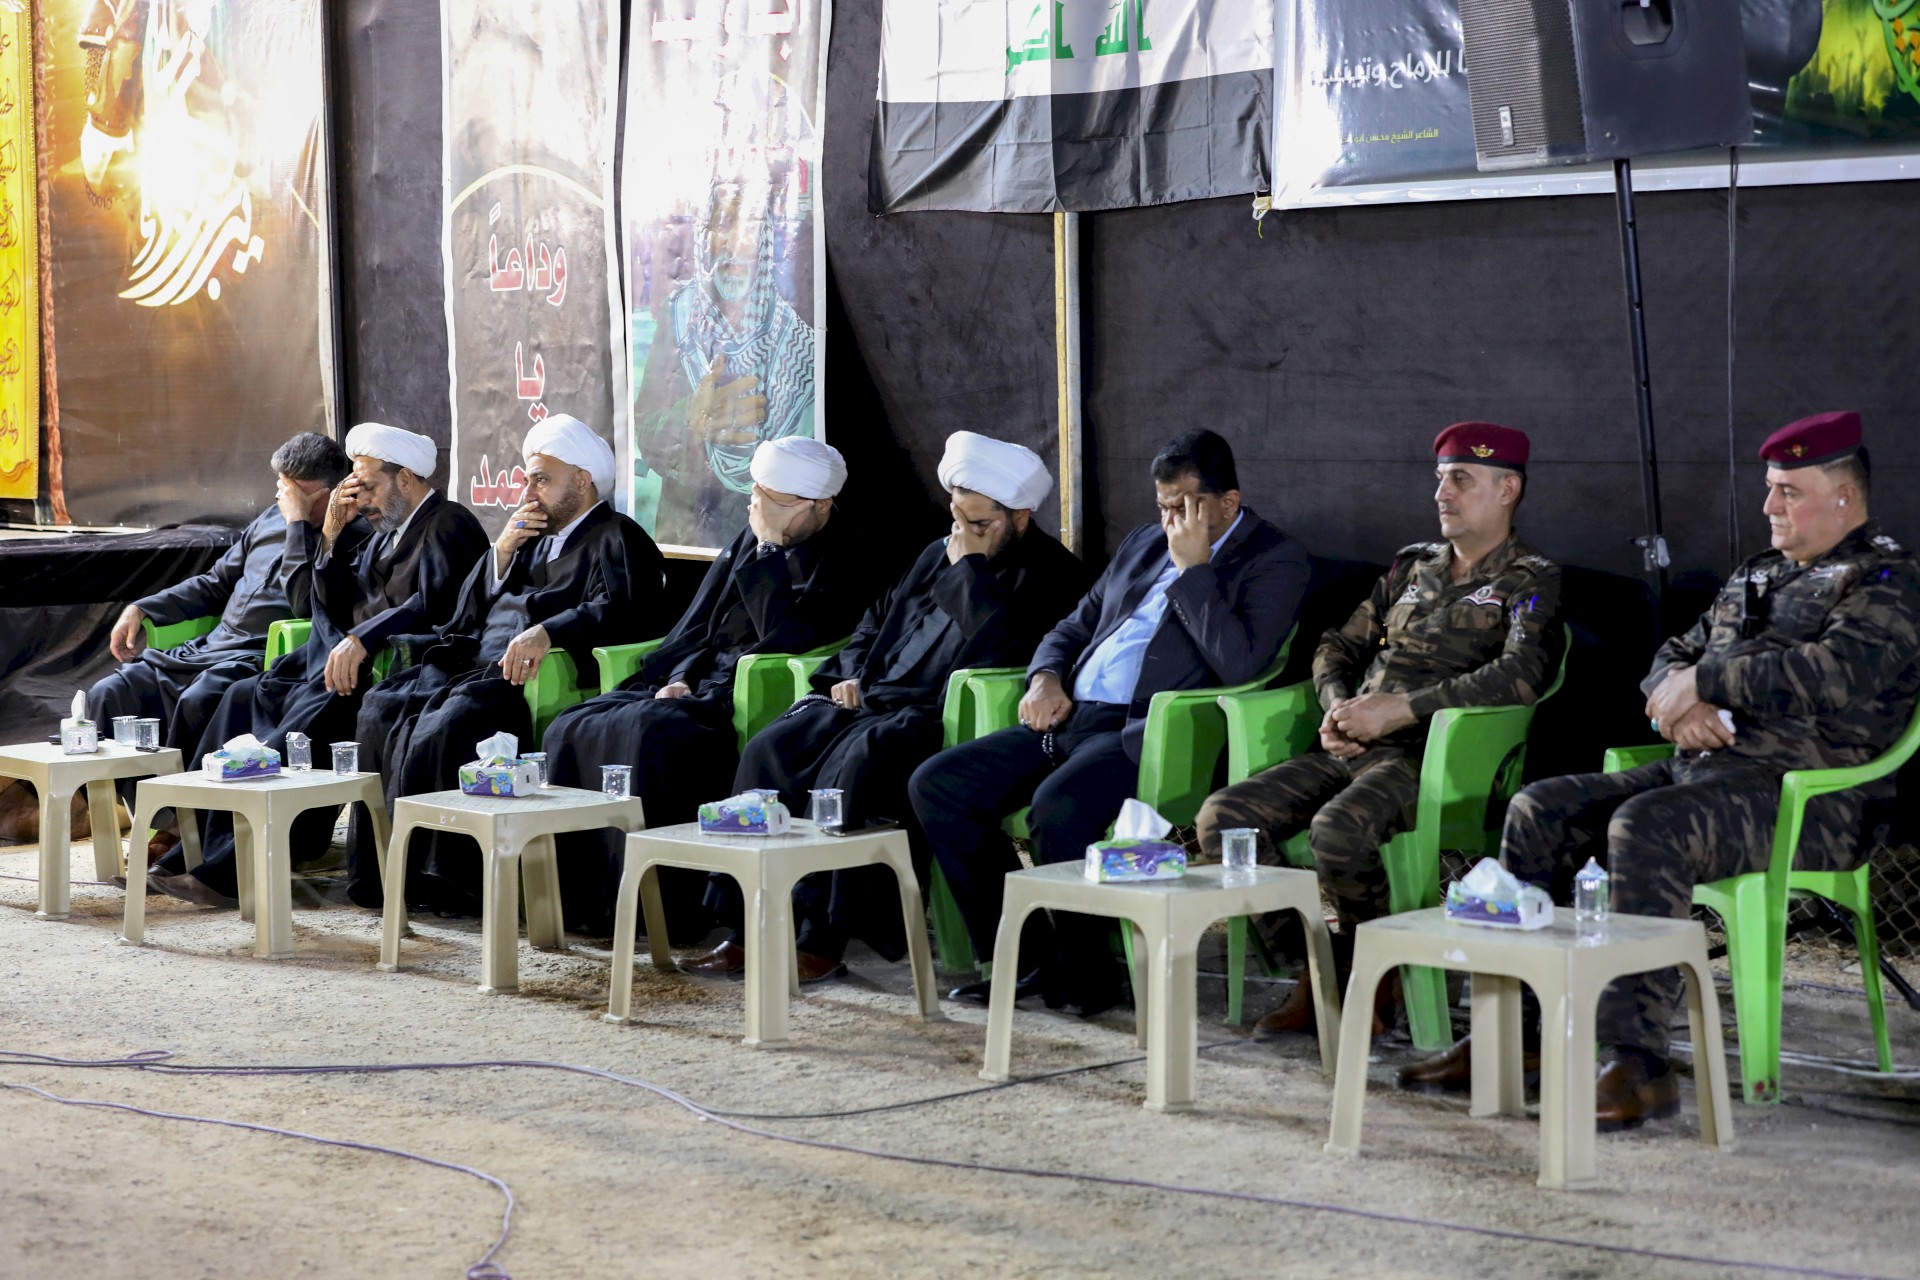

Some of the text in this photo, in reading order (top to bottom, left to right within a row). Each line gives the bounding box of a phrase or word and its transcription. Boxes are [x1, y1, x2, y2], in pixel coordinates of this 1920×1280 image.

[1005, 0, 1153, 76] الله اكر
[1390, 128, 1413, 144] الشيخ
[1414, 126, 1439, 142] الشاعر
[515, 341, 549, 423] يا
